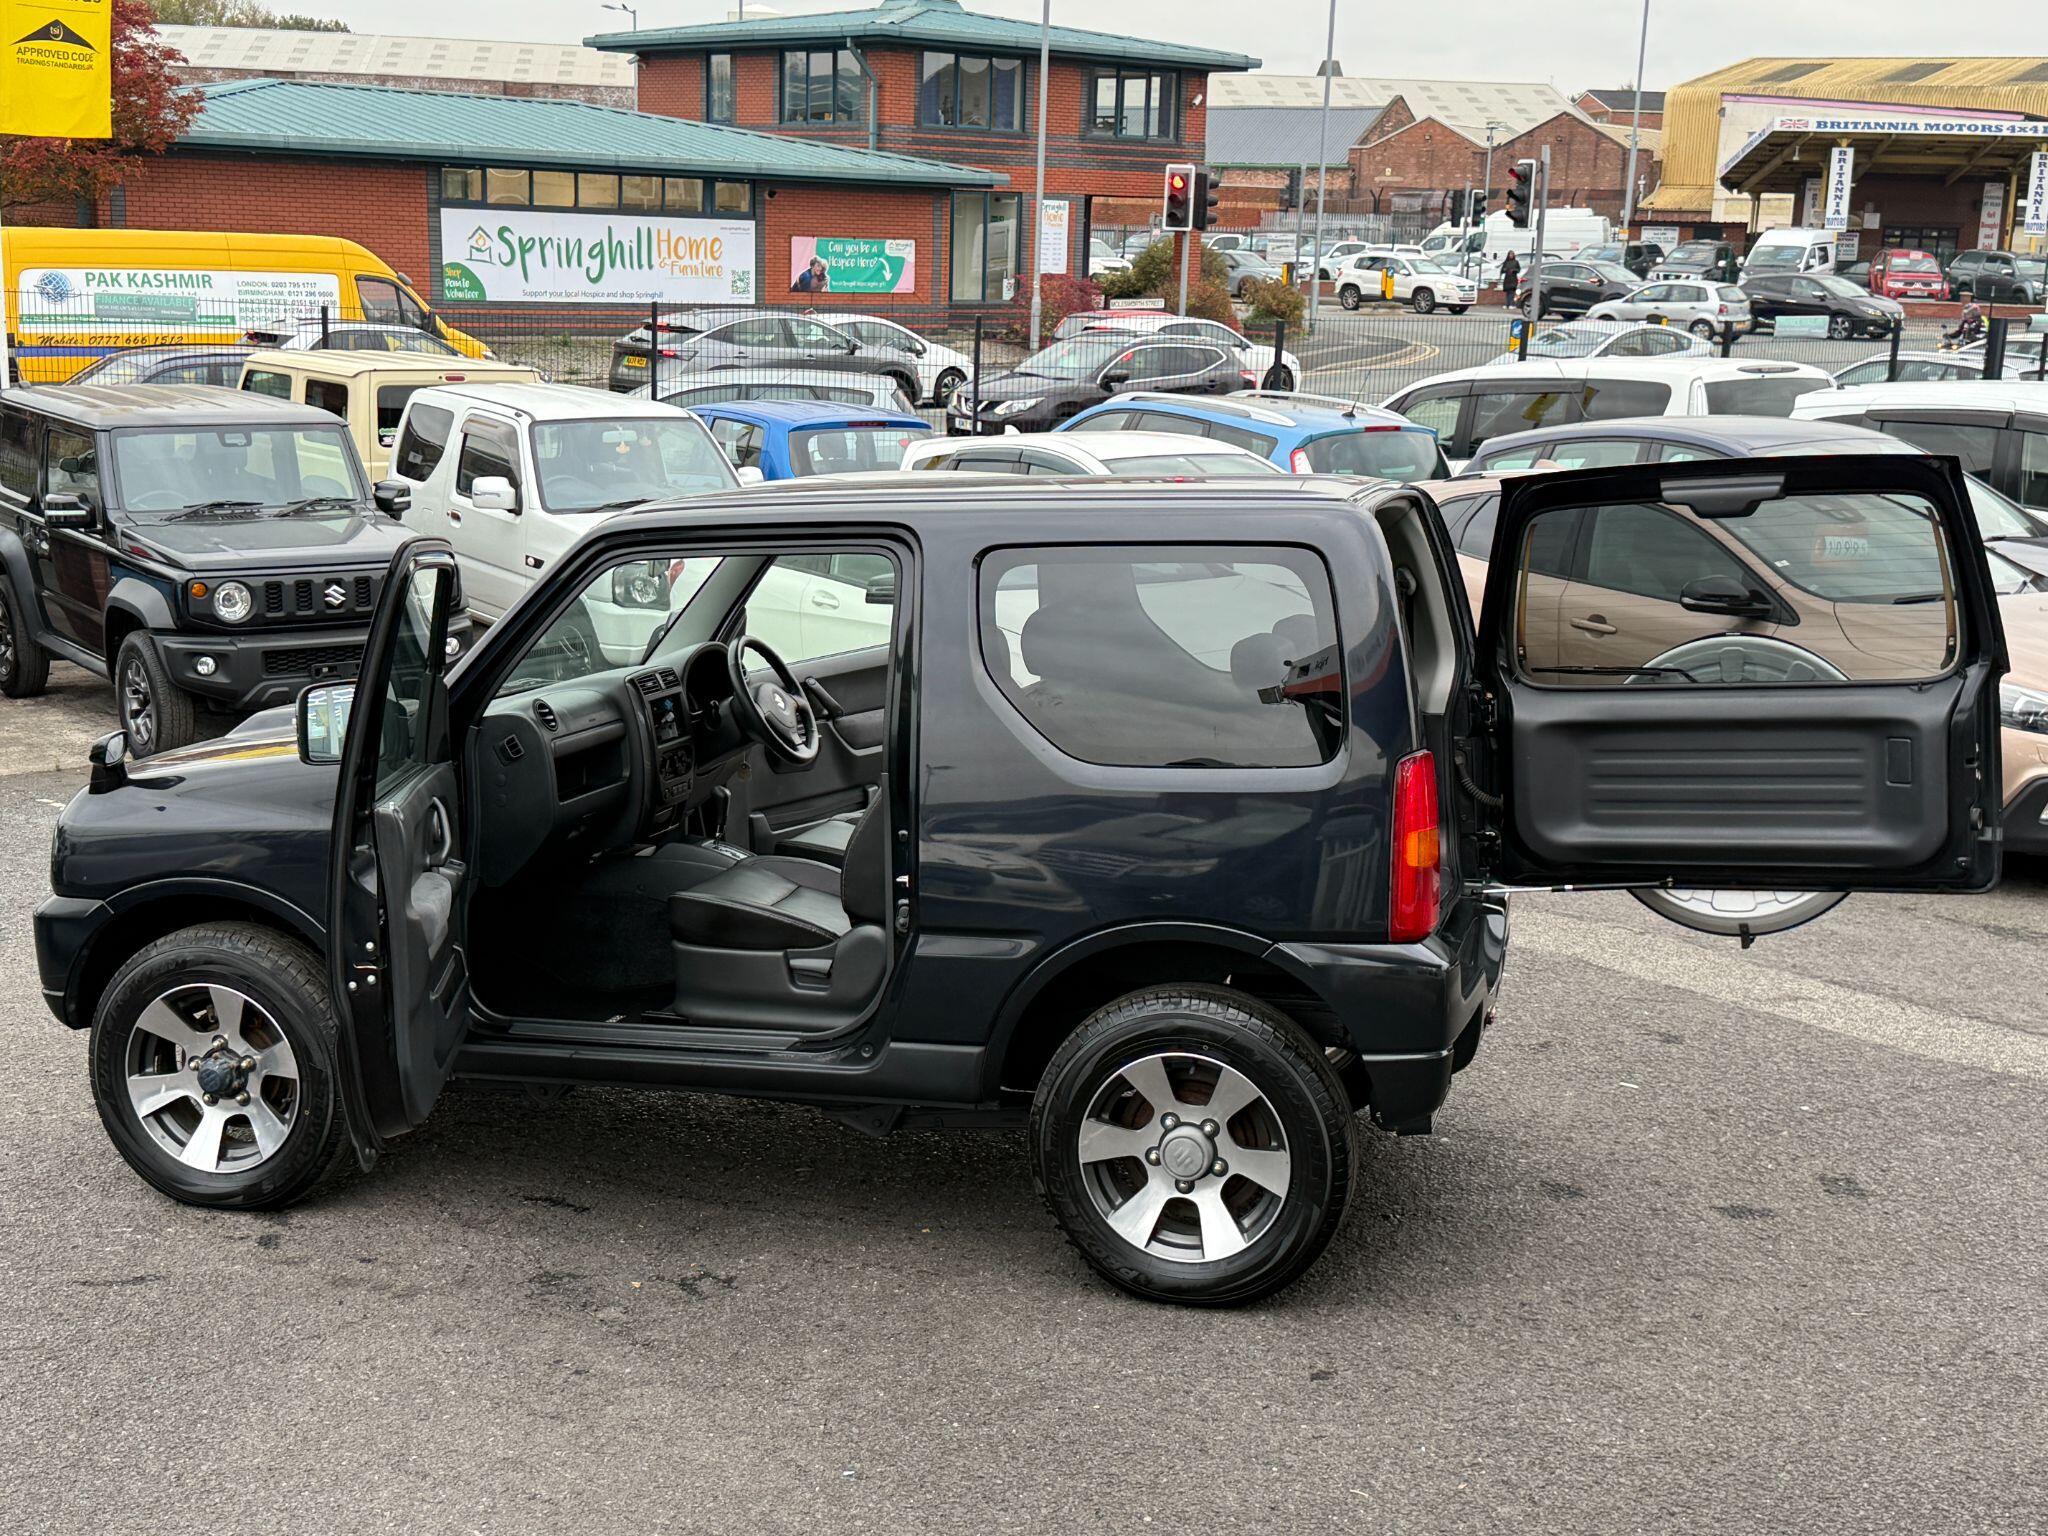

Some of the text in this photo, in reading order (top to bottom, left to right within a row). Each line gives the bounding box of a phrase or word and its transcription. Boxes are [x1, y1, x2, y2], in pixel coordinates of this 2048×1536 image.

[16, 46, 94, 62] APPROVED CODE
[1816, 120, 1919, 130] BRITANNIA
[1924, 123, 2003, 132] MOTORS
[2006, 125, 2039, 134] 4x4
[1833, 150, 1847, 216] BRITANNIA
[2032, 154, 2048, 220] BRITANNIA
[498, 226, 722, 284] Springhill Home
[828, 241, 843, 252] Can
[845, 242, 858, 256] you
[860, 241, 870, 254] be
[872, 245, 878, 253] a
[671, 260, 723, 276] Furniture
[828, 256, 878, 270] Hospice Hero?
[446, 266, 462, 278] Shop
[85, 272, 213, 288] PAK KASHMIR
[446, 288, 480, 299] Volunteer
[548, 290, 564, 298] your
[581, 290, 605, 298] Hospice
[619, 290, 634, 299] shop
[636, 290, 664, 300] Springhill
[96, 294, 193, 308] FINANCE AVAILABLE
[38, 335, 184, 346] Mobile: 0777 666 1512
